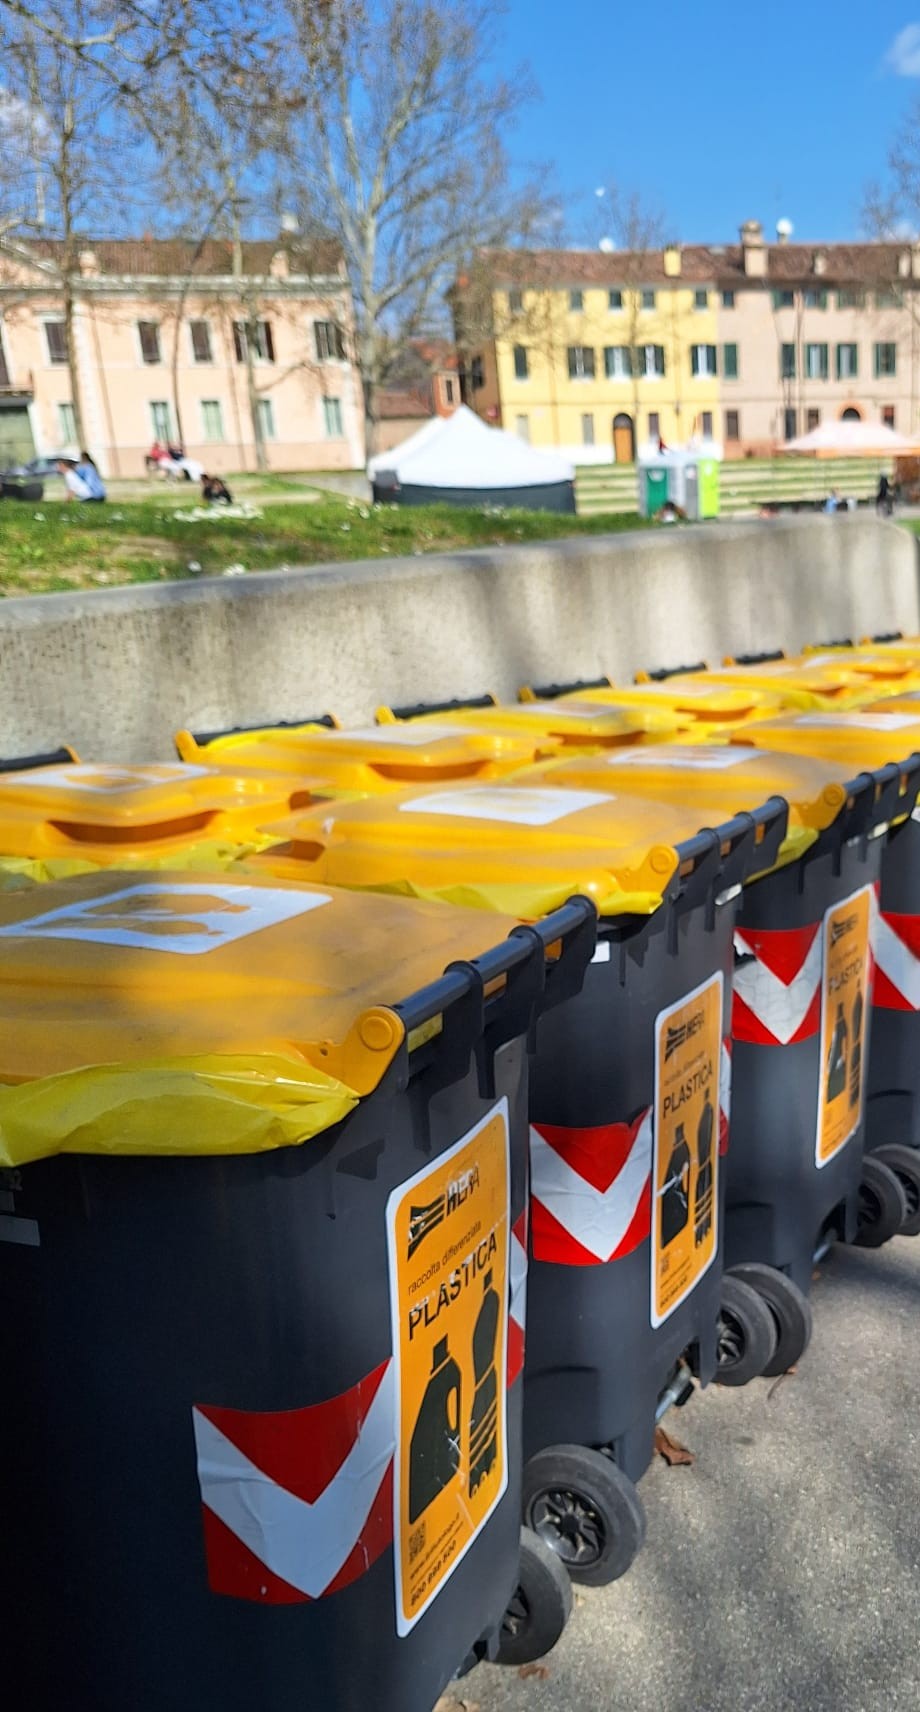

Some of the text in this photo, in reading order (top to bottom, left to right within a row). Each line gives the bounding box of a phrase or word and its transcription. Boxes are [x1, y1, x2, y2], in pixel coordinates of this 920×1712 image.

[663, 1060, 713, 1118] PLASTICA
[408, 1220, 482, 1296] raccolta differenziata
[409, 1231, 497, 1341] PLASTICA
